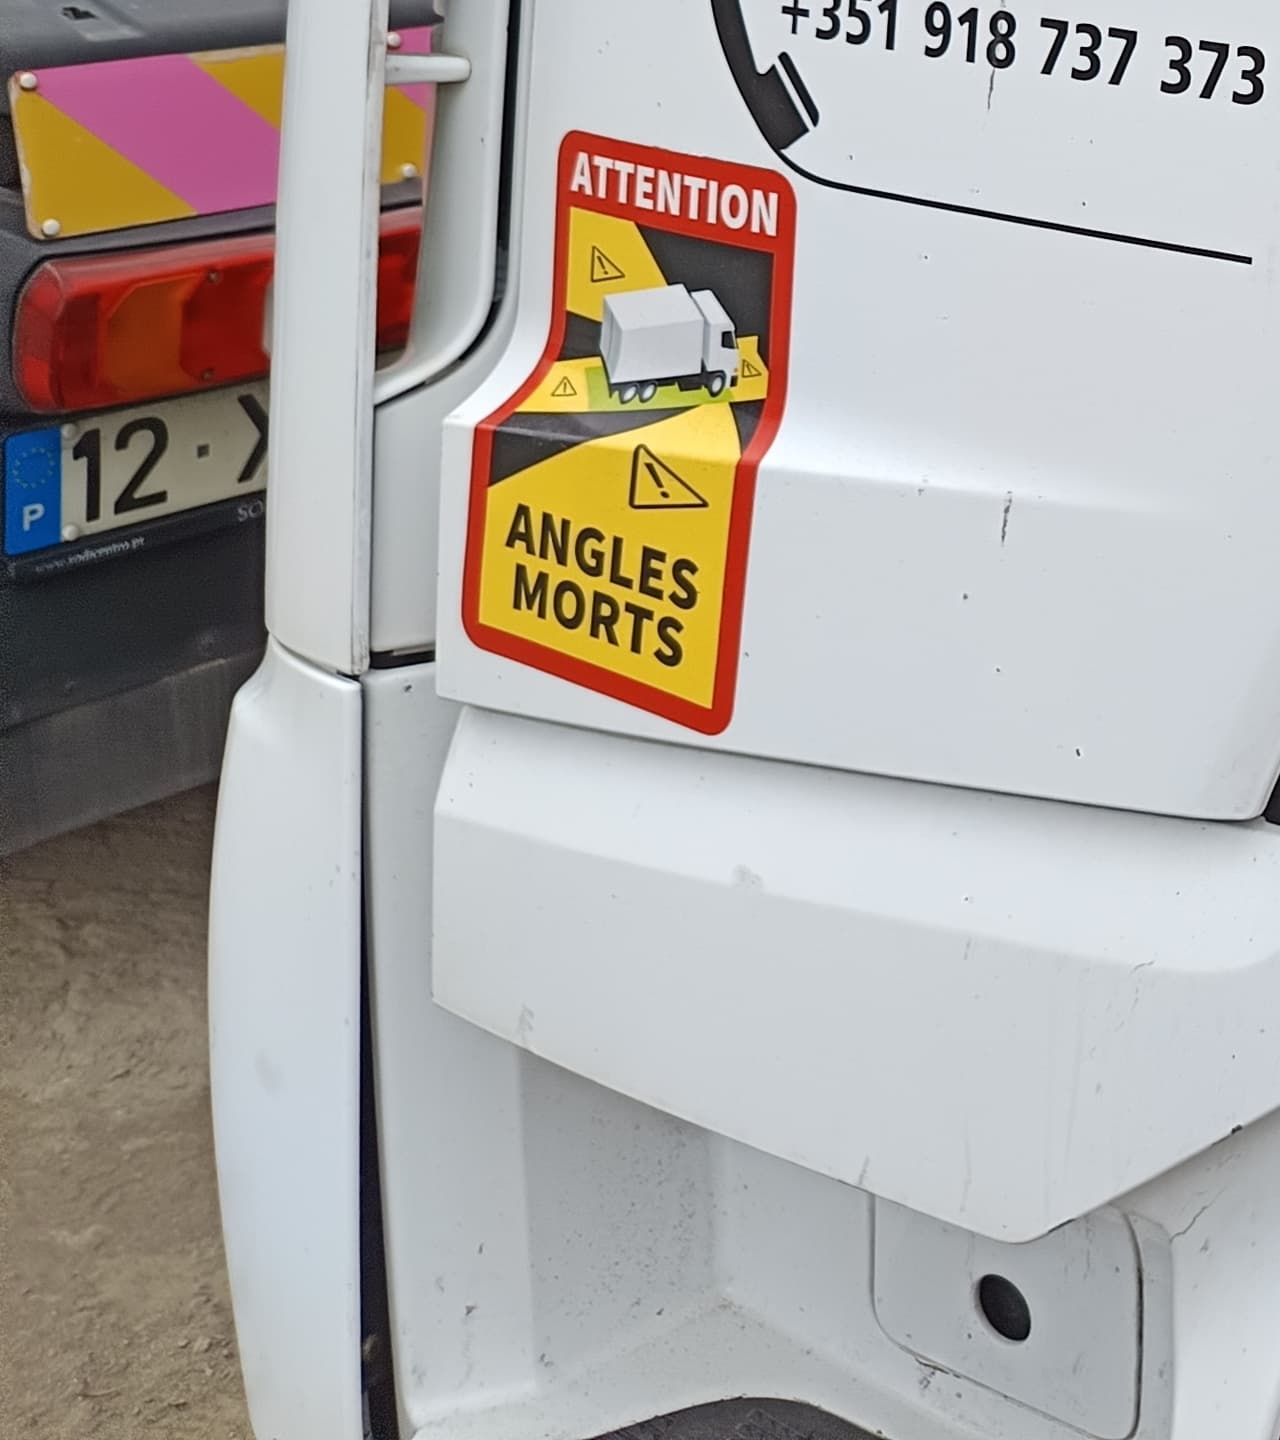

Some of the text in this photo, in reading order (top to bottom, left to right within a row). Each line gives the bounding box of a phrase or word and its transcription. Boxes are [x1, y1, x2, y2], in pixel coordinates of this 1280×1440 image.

[923, 1, 1017, 69] 918
[1039, 17, 1138, 86] 737
[1160, 35, 1266, 105] 373
[569, 151, 780, 237] ATTENTION
[22, 503, 45, 532] P
[505, 503, 699, 611] ANGLES
[512, 563, 684, 668] MORTS
